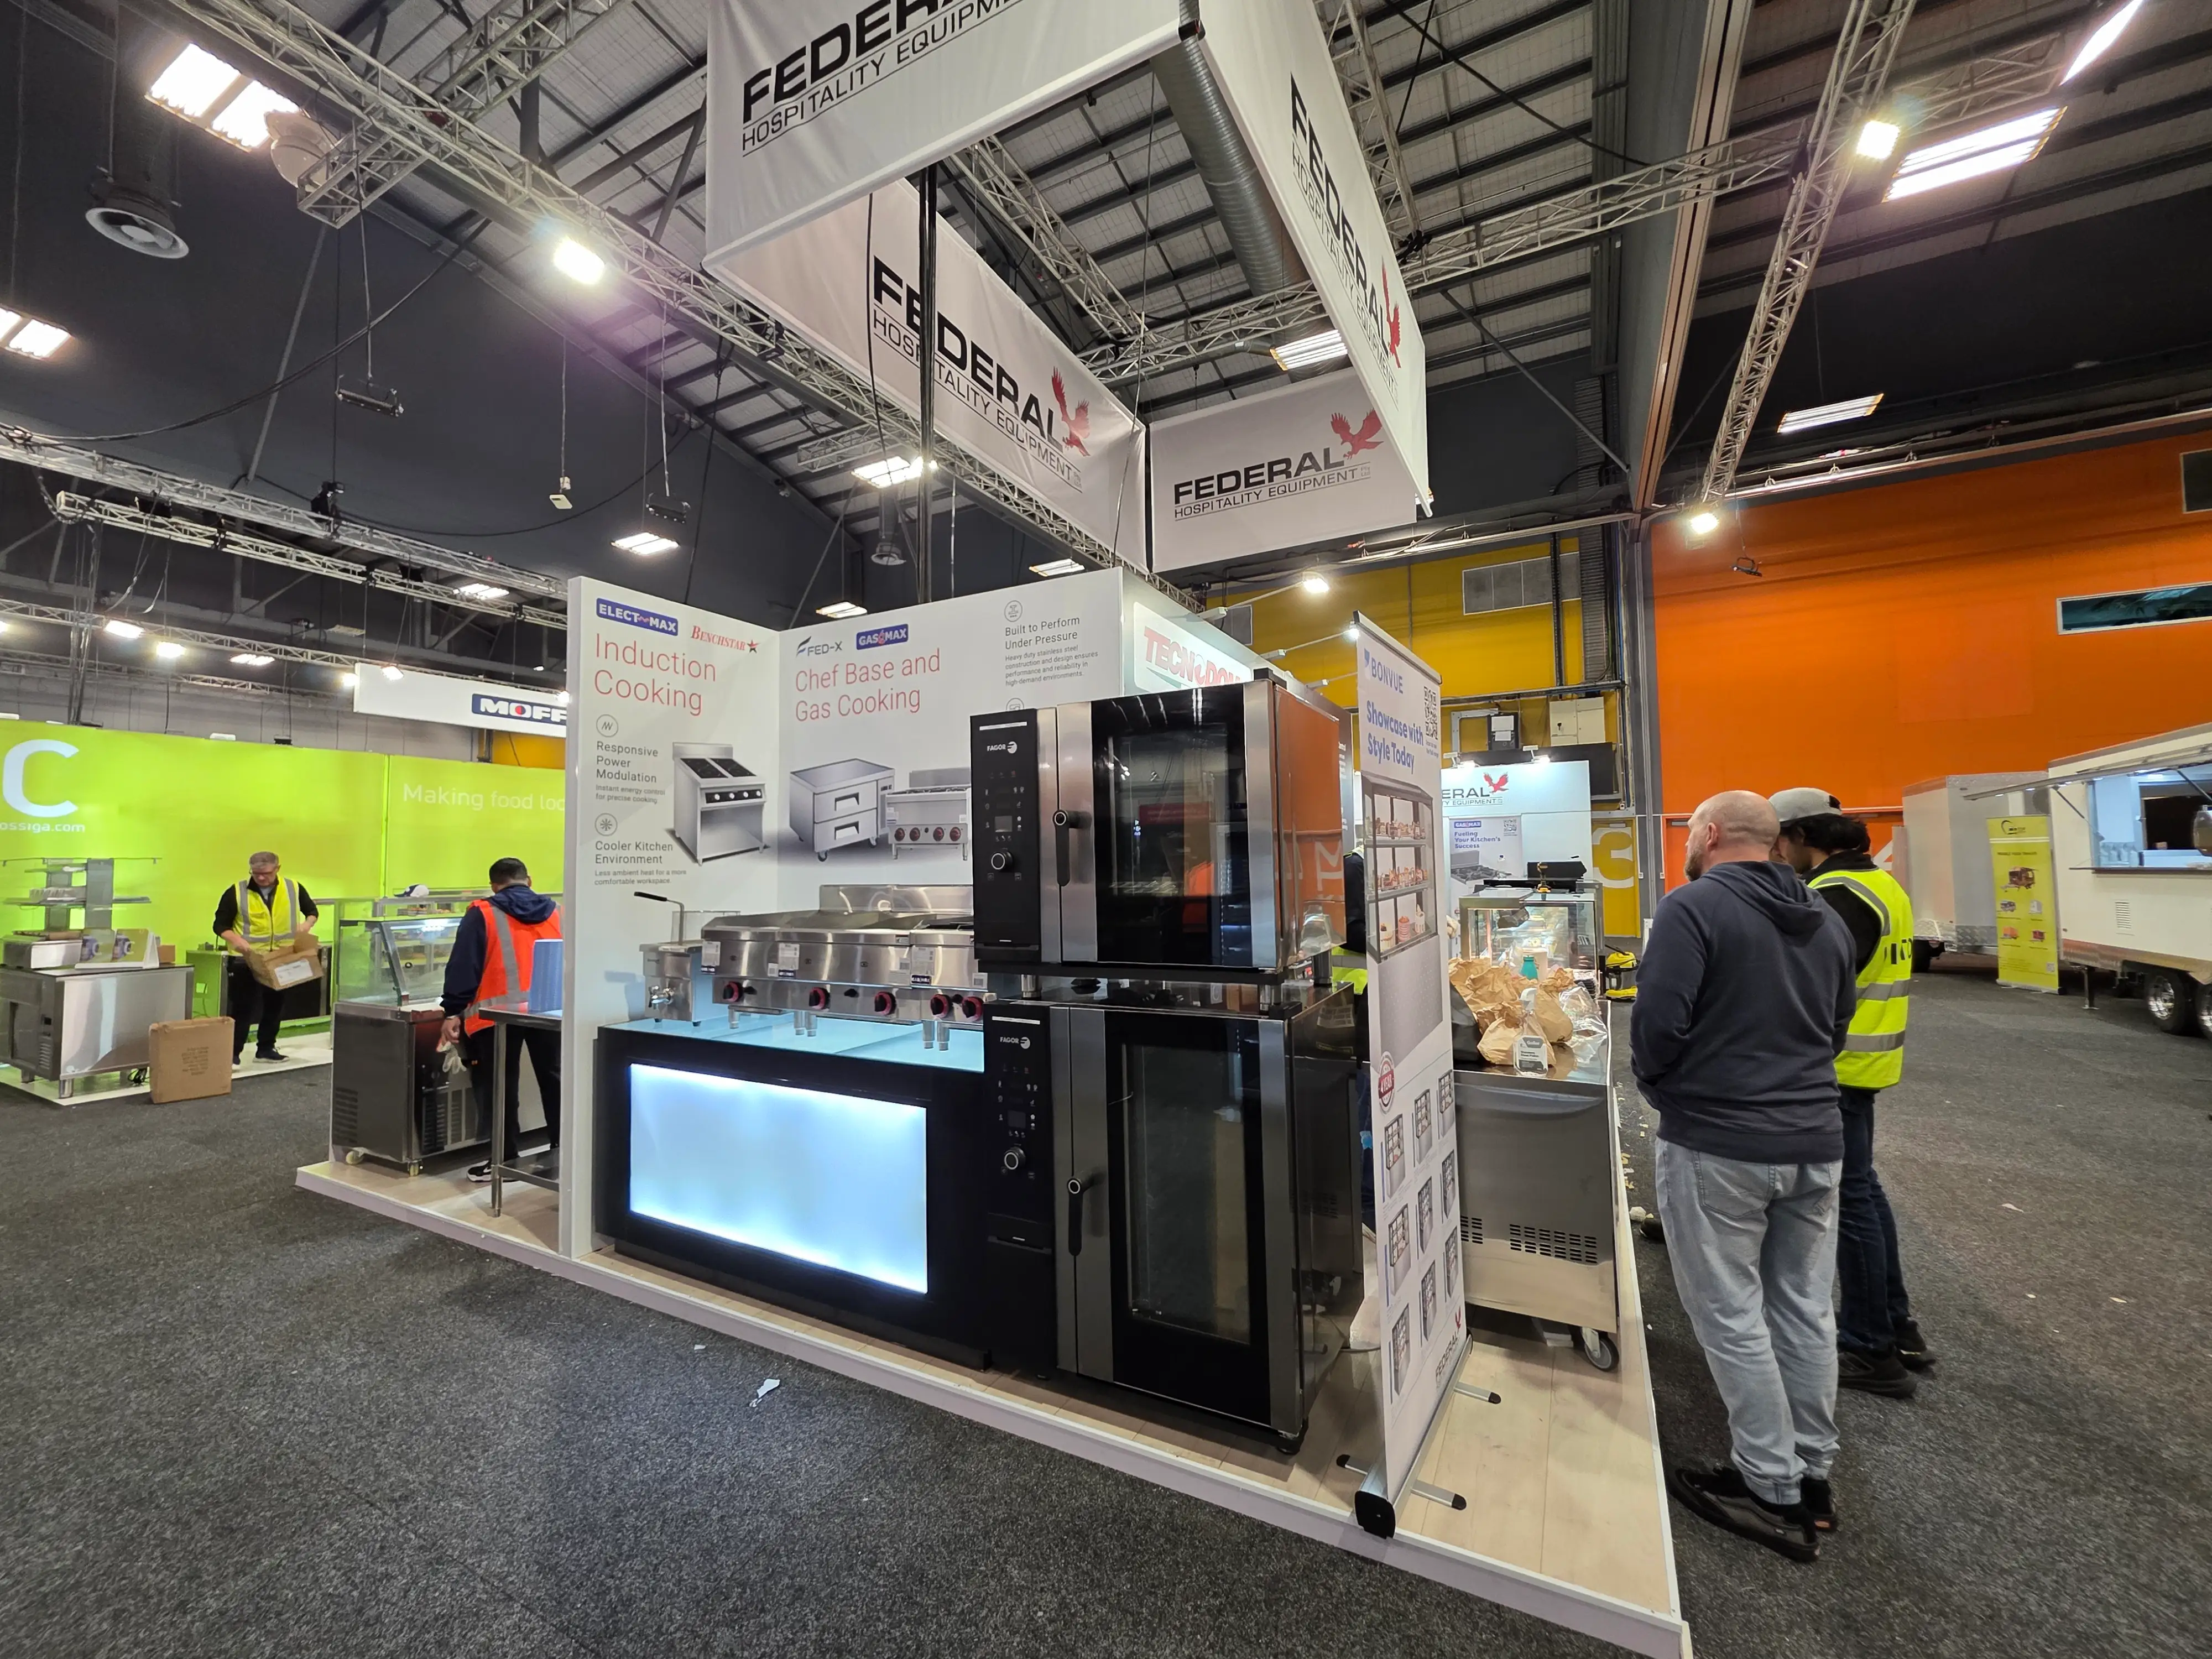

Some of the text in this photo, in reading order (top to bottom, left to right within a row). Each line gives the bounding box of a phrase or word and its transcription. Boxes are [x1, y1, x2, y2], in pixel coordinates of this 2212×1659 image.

[742, 0, 1011, 151] HOSPITALITY EQUIPM
[1290, 71, 1389, 358] FEDERAL
[1292, 142, 1394, 393] HOSPITALITY EQUIPMENT
[997, 415, 1072, 481] EQUIPMENT
[1174, 447, 1344, 504] FEDERAL
[1175, 468, 1358, 519] HOSPITALITY EQUIPMENT
[1005, 625, 1025, 636] Built
[1041, 617, 1080, 630] Perform
[1005, 632, 1078, 649] Under Pressure
[596, 633, 716, 681] Induction
[807, 641, 842, 656] FED-X
[1005, 660, 1040, 669] construction
[1053, 654, 1073, 662] design
[1037, 648, 1063, 656] stainless
[796, 648, 940, 691] Chef Base and
[1005, 667, 1041, 679] performance
[1055, 662, 1081, 671] reliability
[1371, 657, 1404, 693] BONVUE
[594, 670, 701, 716] Cooking
[796, 688, 920, 721] Gas Cooking
[480, 698, 567, 722] MOFF
[1367, 700, 1423, 746] Showcase with
[597, 741, 658, 757] Responsive
[597, 755, 630, 768] Power
[1368, 733, 1390, 764] Style
[1391, 742, 1415, 774] Today
[597, 769, 656, 782] Modulation
[403, 783, 483, 811] Making
[491, 791, 533, 810] food
[633, 795, 658, 804] cooking
[595, 841, 674, 852] Cooler Kitchen
[595, 854, 662, 864] Environment
